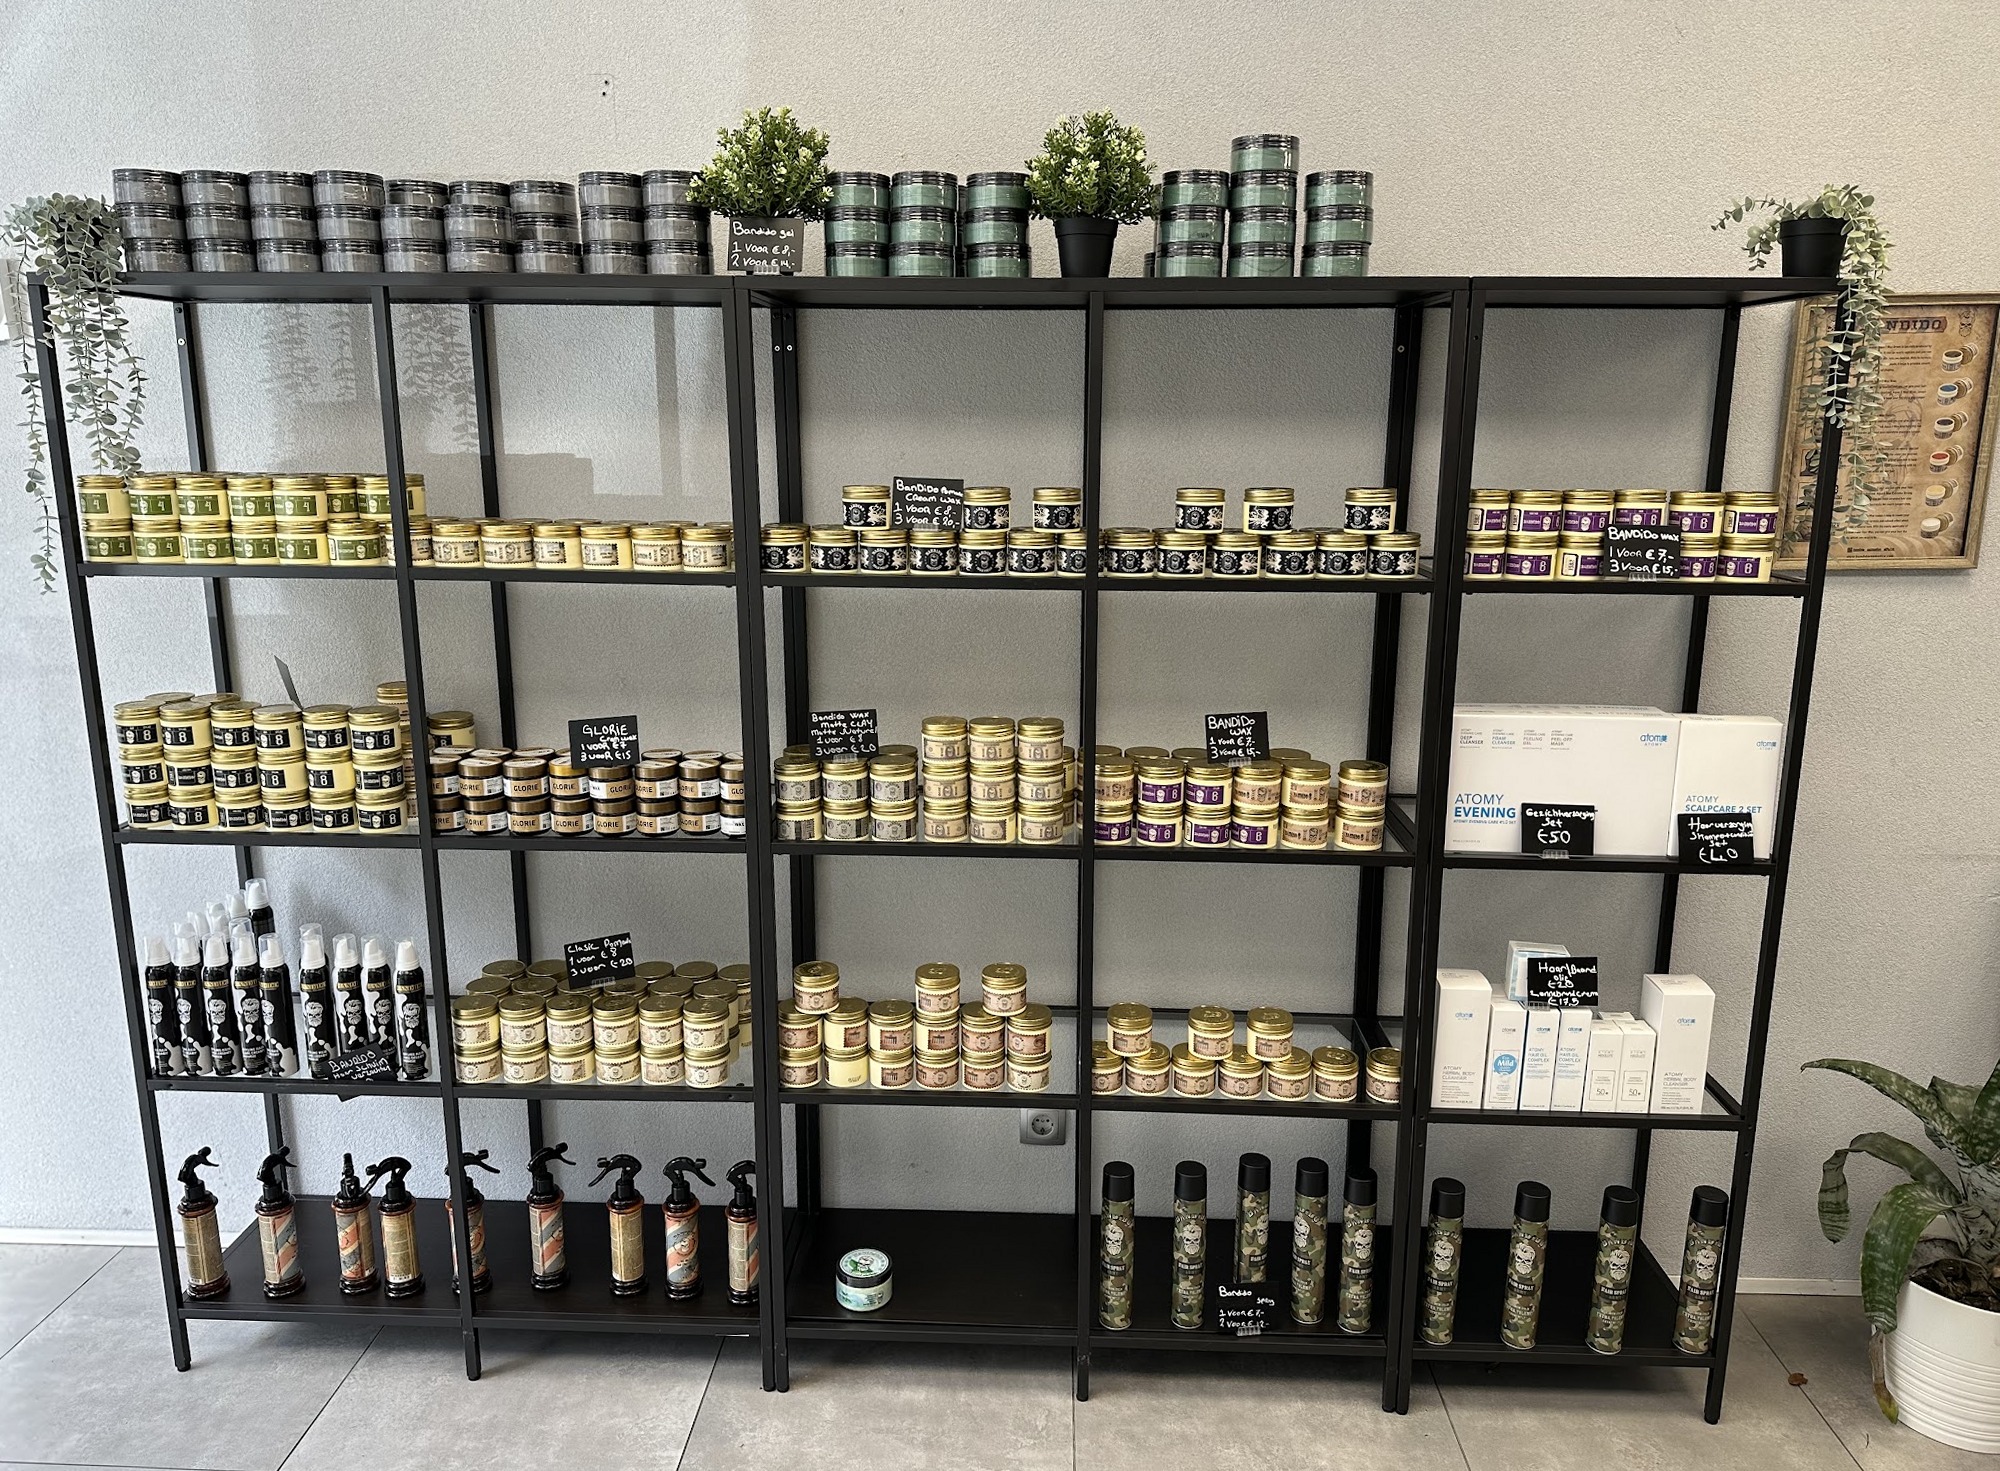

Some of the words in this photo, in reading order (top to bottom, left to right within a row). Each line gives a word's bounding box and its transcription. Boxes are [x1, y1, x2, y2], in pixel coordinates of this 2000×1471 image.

[732, 221, 776, 236] Bandido
[779, 229, 794, 239] gel
[732, 242, 742, 253] 1
[730, 254, 739, 267] 2
[1886, 319, 1942, 331] NDIDO
[893, 502, 902, 512] 1
[894, 513, 903, 525] 3
[1610, 559, 1619, 572] 3
[811, 713, 845, 722] Bandido
[1209, 736, 1216, 745] 1
[581, 743, 585, 751] 1
[815, 747, 823, 756] 3
[580, 752, 587, 762] 3
[1210, 746, 1219, 759] 3
[513, 783, 539, 792] GLORIE
[1454, 793, 1504, 805] ATOMY
[1686, 795, 1719, 803] ATOMY
[1454, 806, 1516, 818] EVENING
[1685, 804, 1736, 813] SCALPCARE
[512, 819, 536, 827] GLORIE
[555, 819, 579, 827] GLORIE
[568, 956, 574, 965] 1
[570, 968, 578, 977] 3
[1219, 1309, 1227, 1317] 1
[1219, 1317, 1225, 1327] 2
